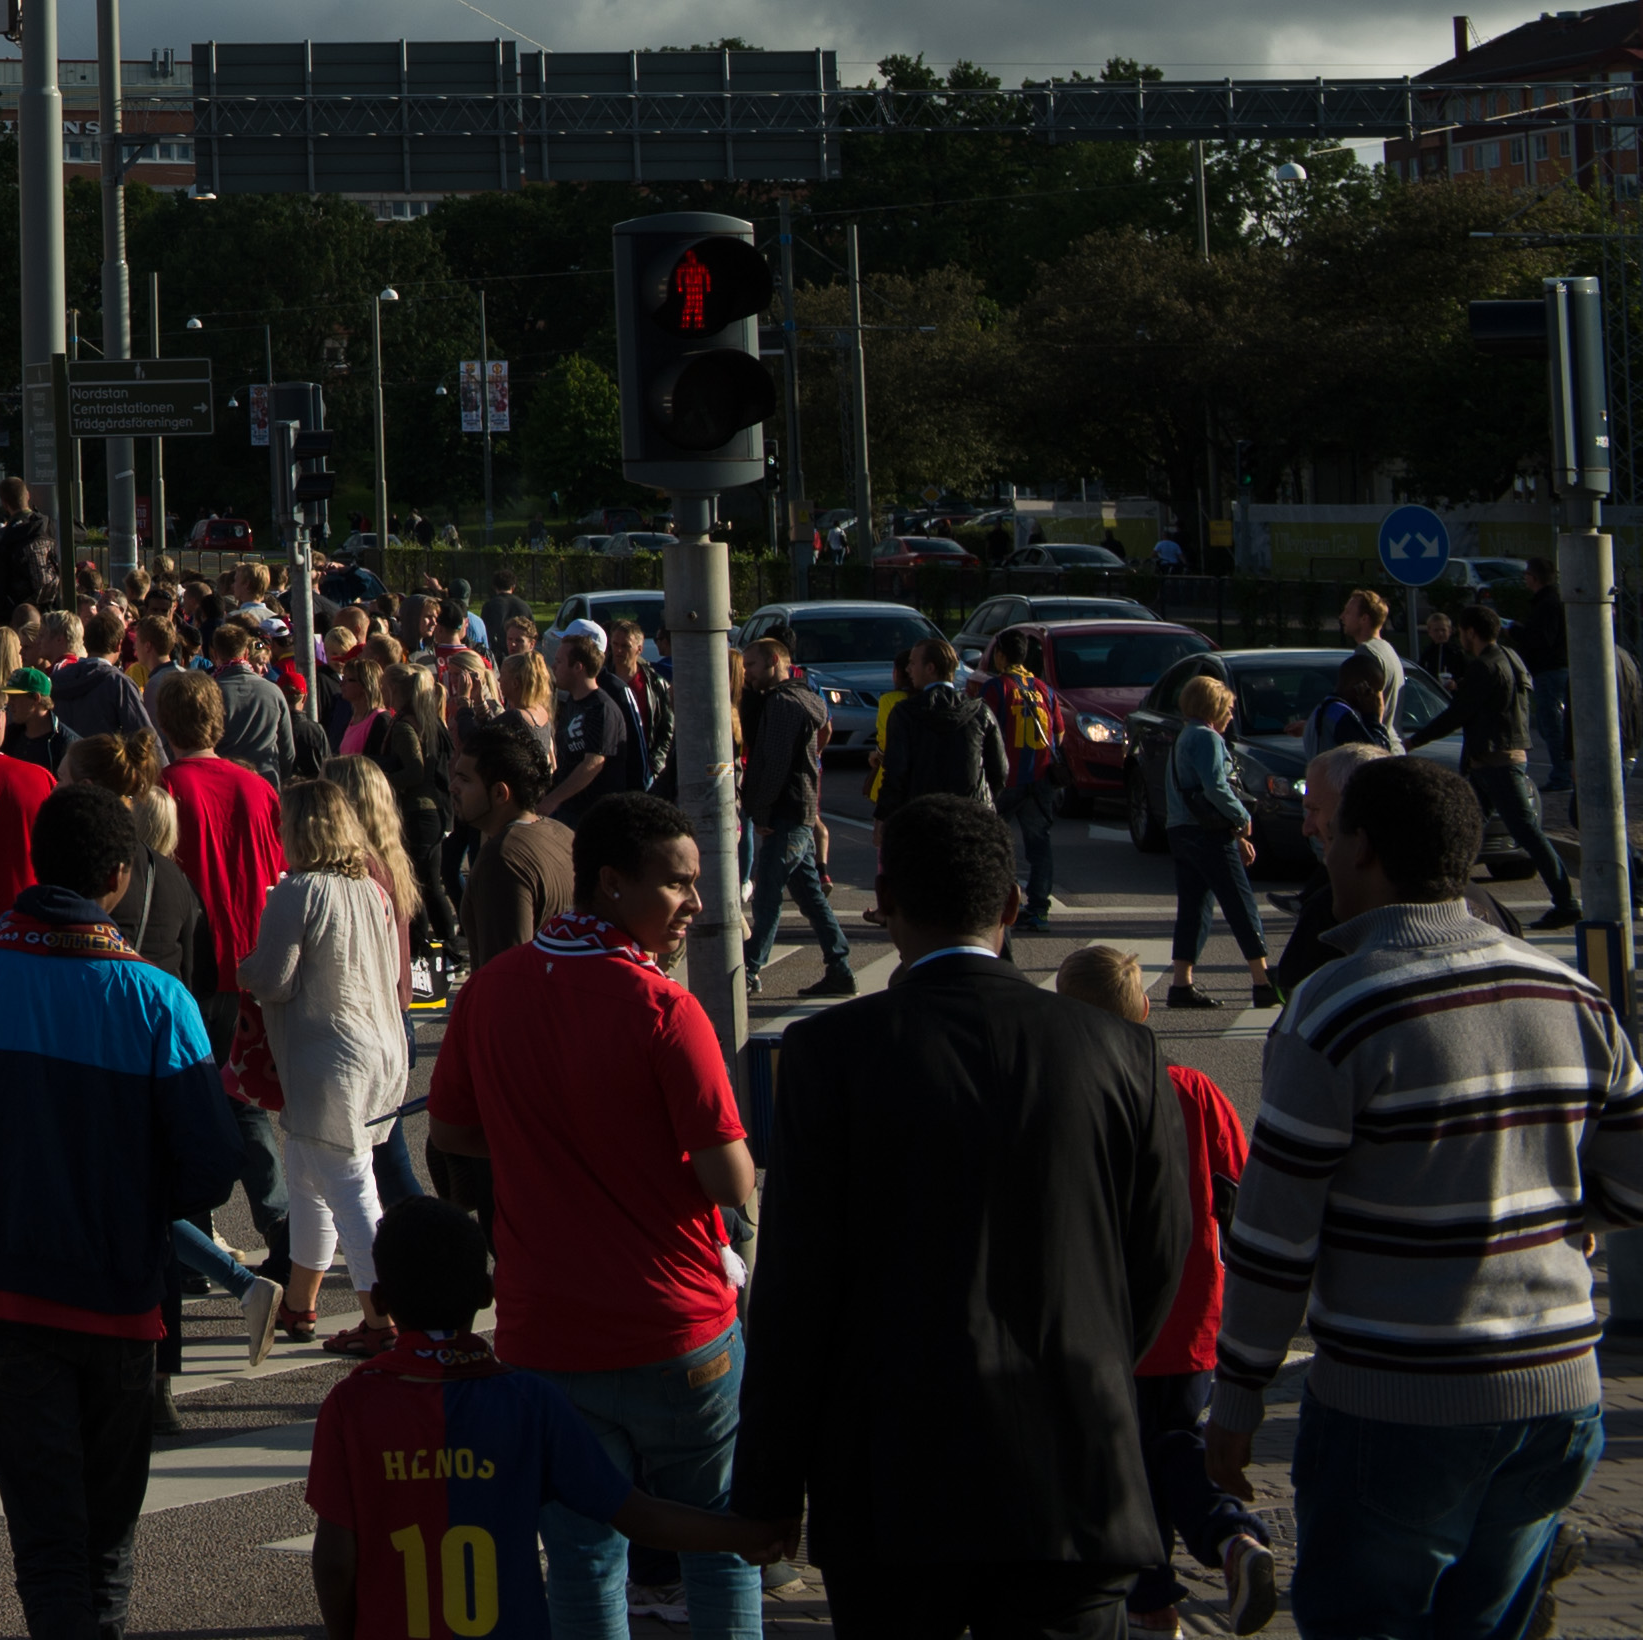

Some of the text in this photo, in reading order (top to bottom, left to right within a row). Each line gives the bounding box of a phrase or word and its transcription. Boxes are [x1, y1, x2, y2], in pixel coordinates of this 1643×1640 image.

[71, 387, 129, 400] Nordstan
[72, 402, 175, 415] Centralstationen
[73, 417, 194, 431] Trädgårdsföreningen
[389, 1523, 500, 1640] 10
